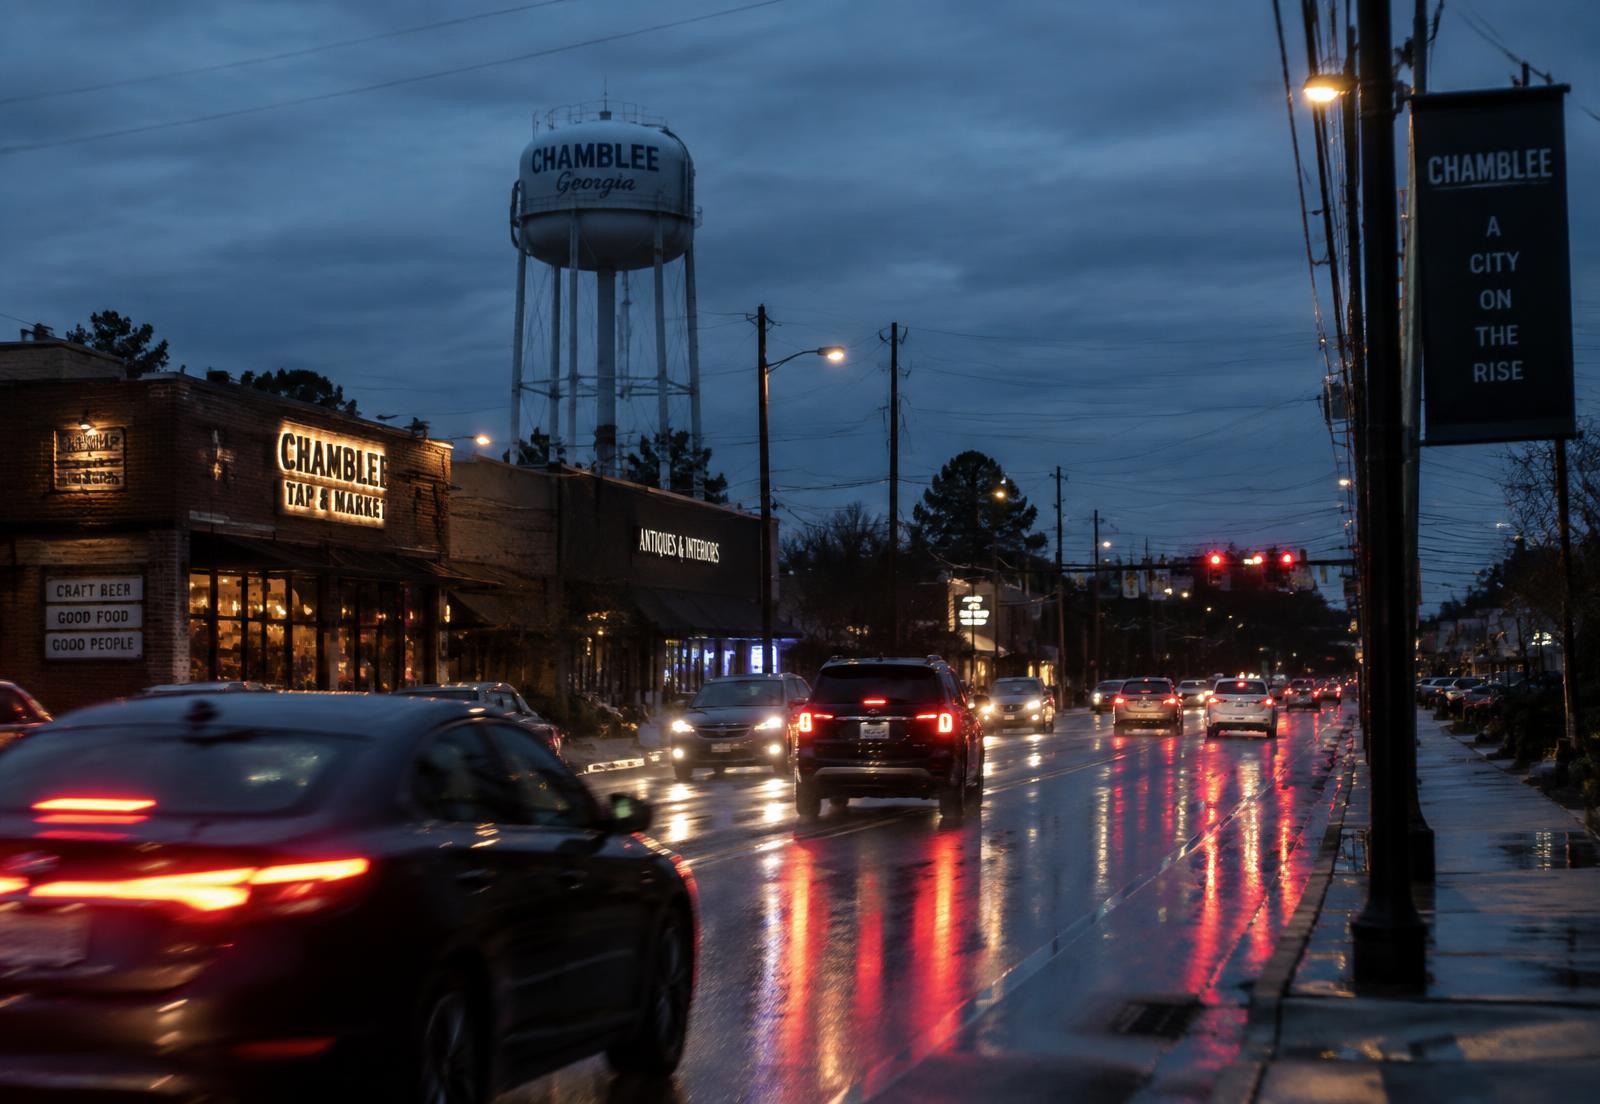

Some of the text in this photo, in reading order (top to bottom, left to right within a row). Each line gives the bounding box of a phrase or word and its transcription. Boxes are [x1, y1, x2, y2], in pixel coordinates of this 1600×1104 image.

[531, 143, 660, 174] CHAMBLEE
[1428, 148, 1553, 185] CHAMBLEE
[556, 171, 636, 198] Georgia
[1486, 215, 1501, 237] A
[1470, 251, 1519, 273] CITY
[1479, 289, 1512, 310] ON
[1475, 325, 1519, 346] THE
[1474, 360, 1524, 383] RISE
[281, 432, 388, 489] CHAMBLEE
[286, 481, 386, 520] TAP & MARKET
[640, 528, 719, 563] ANTIQUES & INTERIORS
[56, 583, 131, 598] CRAFT BEER
[58, 610, 129, 624] GOOD FOOD
[52, 637, 134, 652] GOOD PEOPLE
